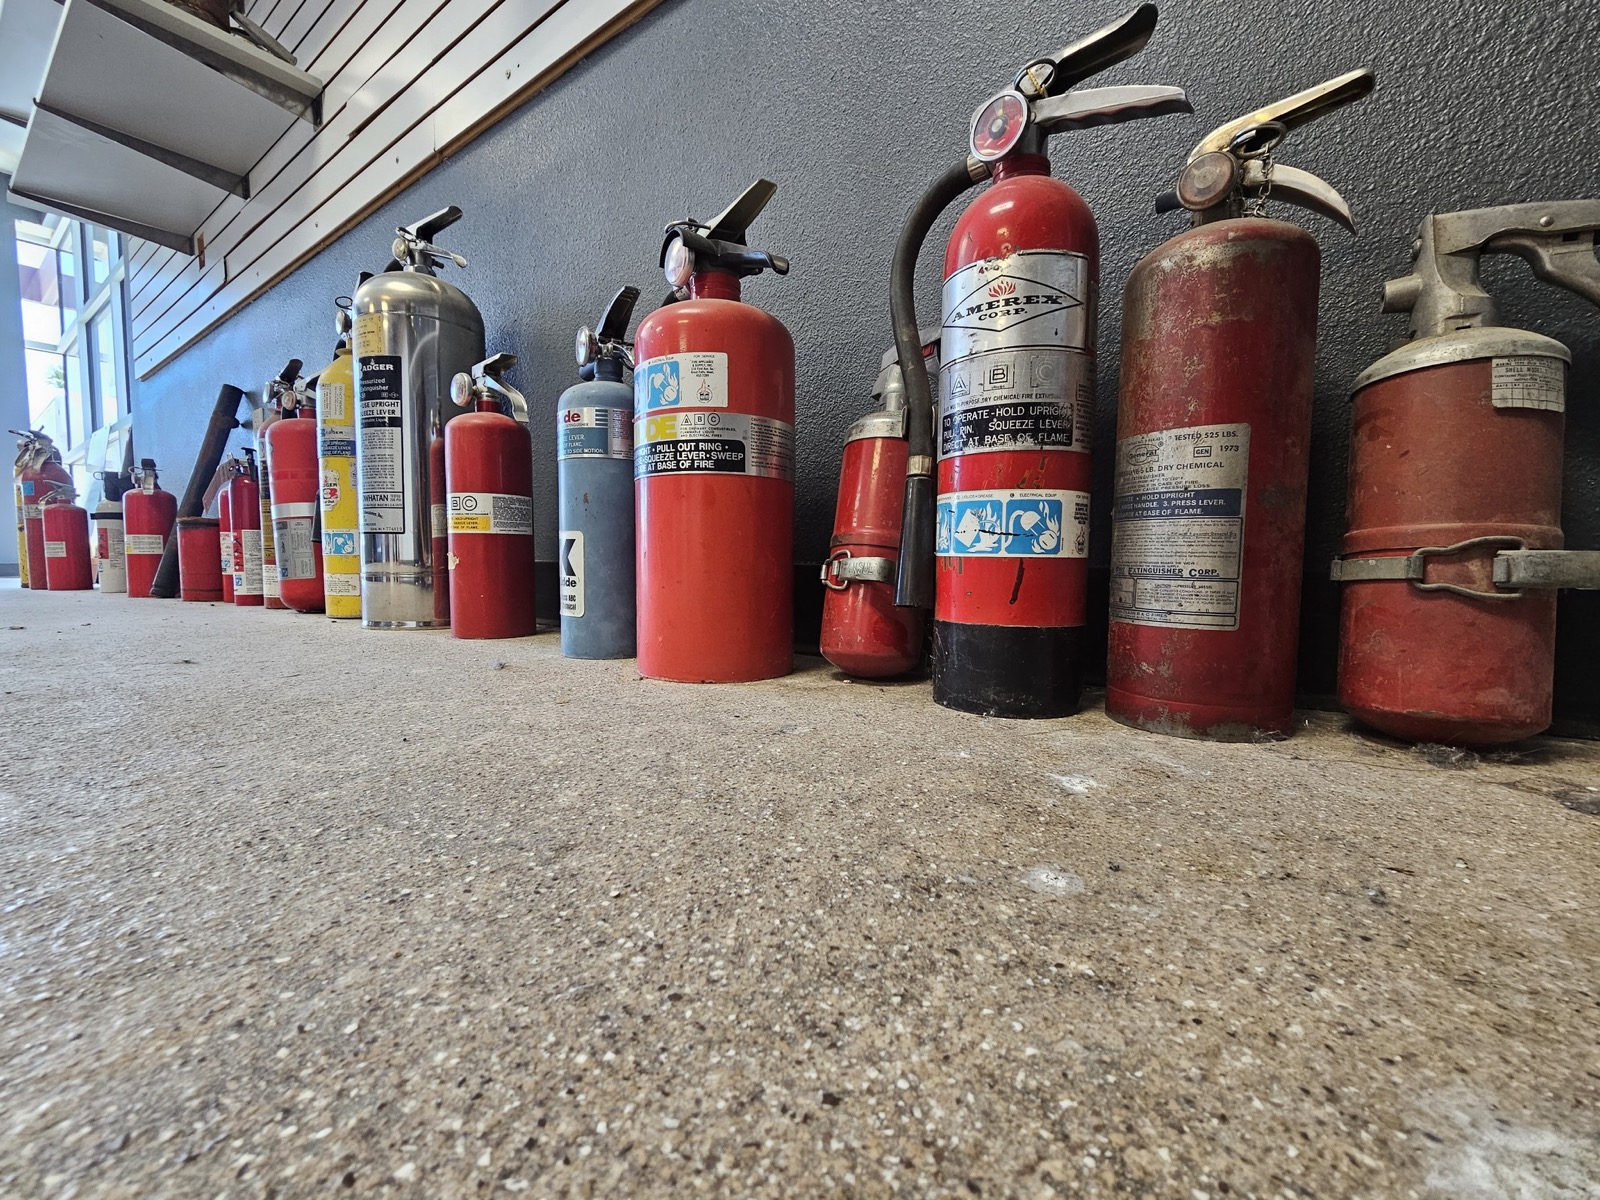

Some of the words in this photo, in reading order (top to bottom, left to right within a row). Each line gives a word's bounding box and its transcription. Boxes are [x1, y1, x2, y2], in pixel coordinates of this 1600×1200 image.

[951, 294, 1063, 323] AMEREX
[978, 307, 1028, 321] CORP.
[992, 368, 1006, 381] B
[993, 393, 1019, 402] CHEMICAL
[563, 410, 581, 423] de
[996, 406, 1025, 417] HOLD
[988, 420, 1035, 431] SQUEEZE
[967, 436, 980, 447] AT
[984, 434, 1012, 445] BASE
[1174, 431, 1202, 441] TESTED
[1204, 431, 1220, 439] 525
[1221, 430, 1239, 438] LBS.
[656, 443, 676, 453] PULL
[677, 442, 697, 451] OUT
[698, 442, 722, 451] RING
[1219, 444, 1240, 452] 1973
[1128, 449, 1157, 459] General
[647, 462, 656, 472] AT
[657, 461, 677, 470] BASE
[679, 460, 692, 469] OF
[694, 460, 715, 469] FIRE
[1176, 461, 1225, 470] CHEMICAL
[1141, 493, 1160, 501] HOLD
[1160, 491, 1195, 499] UPRIGHT
[1171, 499, 1197, 507] PRESS
[1142, 509, 1160, 517] BASE
[1161, 508, 1172, 516] OF
[1128, 566, 1184, 576] EXTINGUISHER
[1188, 568, 1220, 577] CORP.
